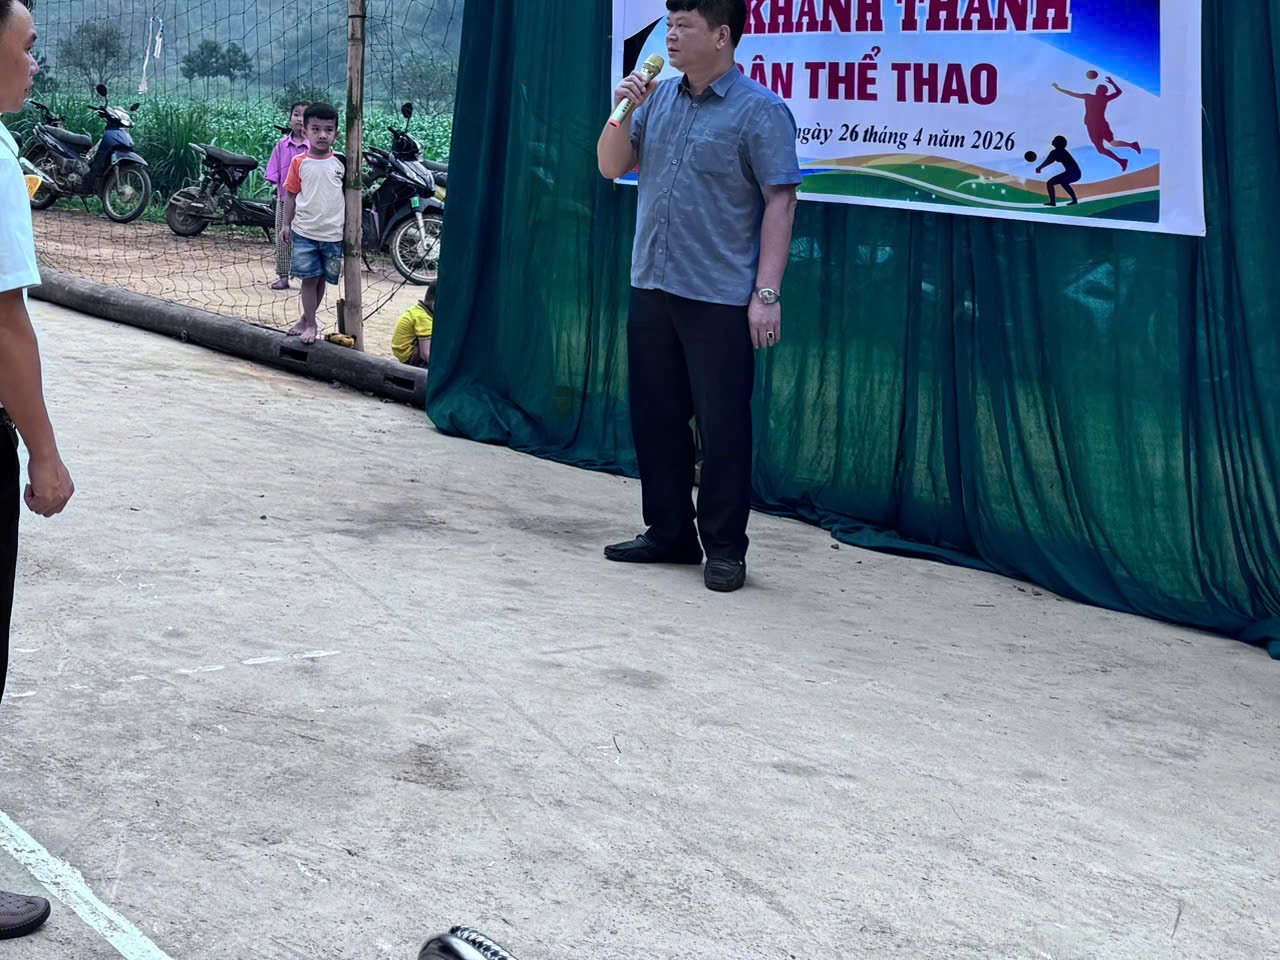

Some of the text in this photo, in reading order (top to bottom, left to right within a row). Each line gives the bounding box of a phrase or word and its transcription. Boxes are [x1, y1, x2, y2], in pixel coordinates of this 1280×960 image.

[736, 46, 998, 105] ÂN THỂ THAO
[838, 123, 859, 142] 26
[863, 124, 908, 150] tháng
[912, 128, 923, 146] 4
[928, 125, 966, 148] năm
[970, 129, 1016, 151] 2026
